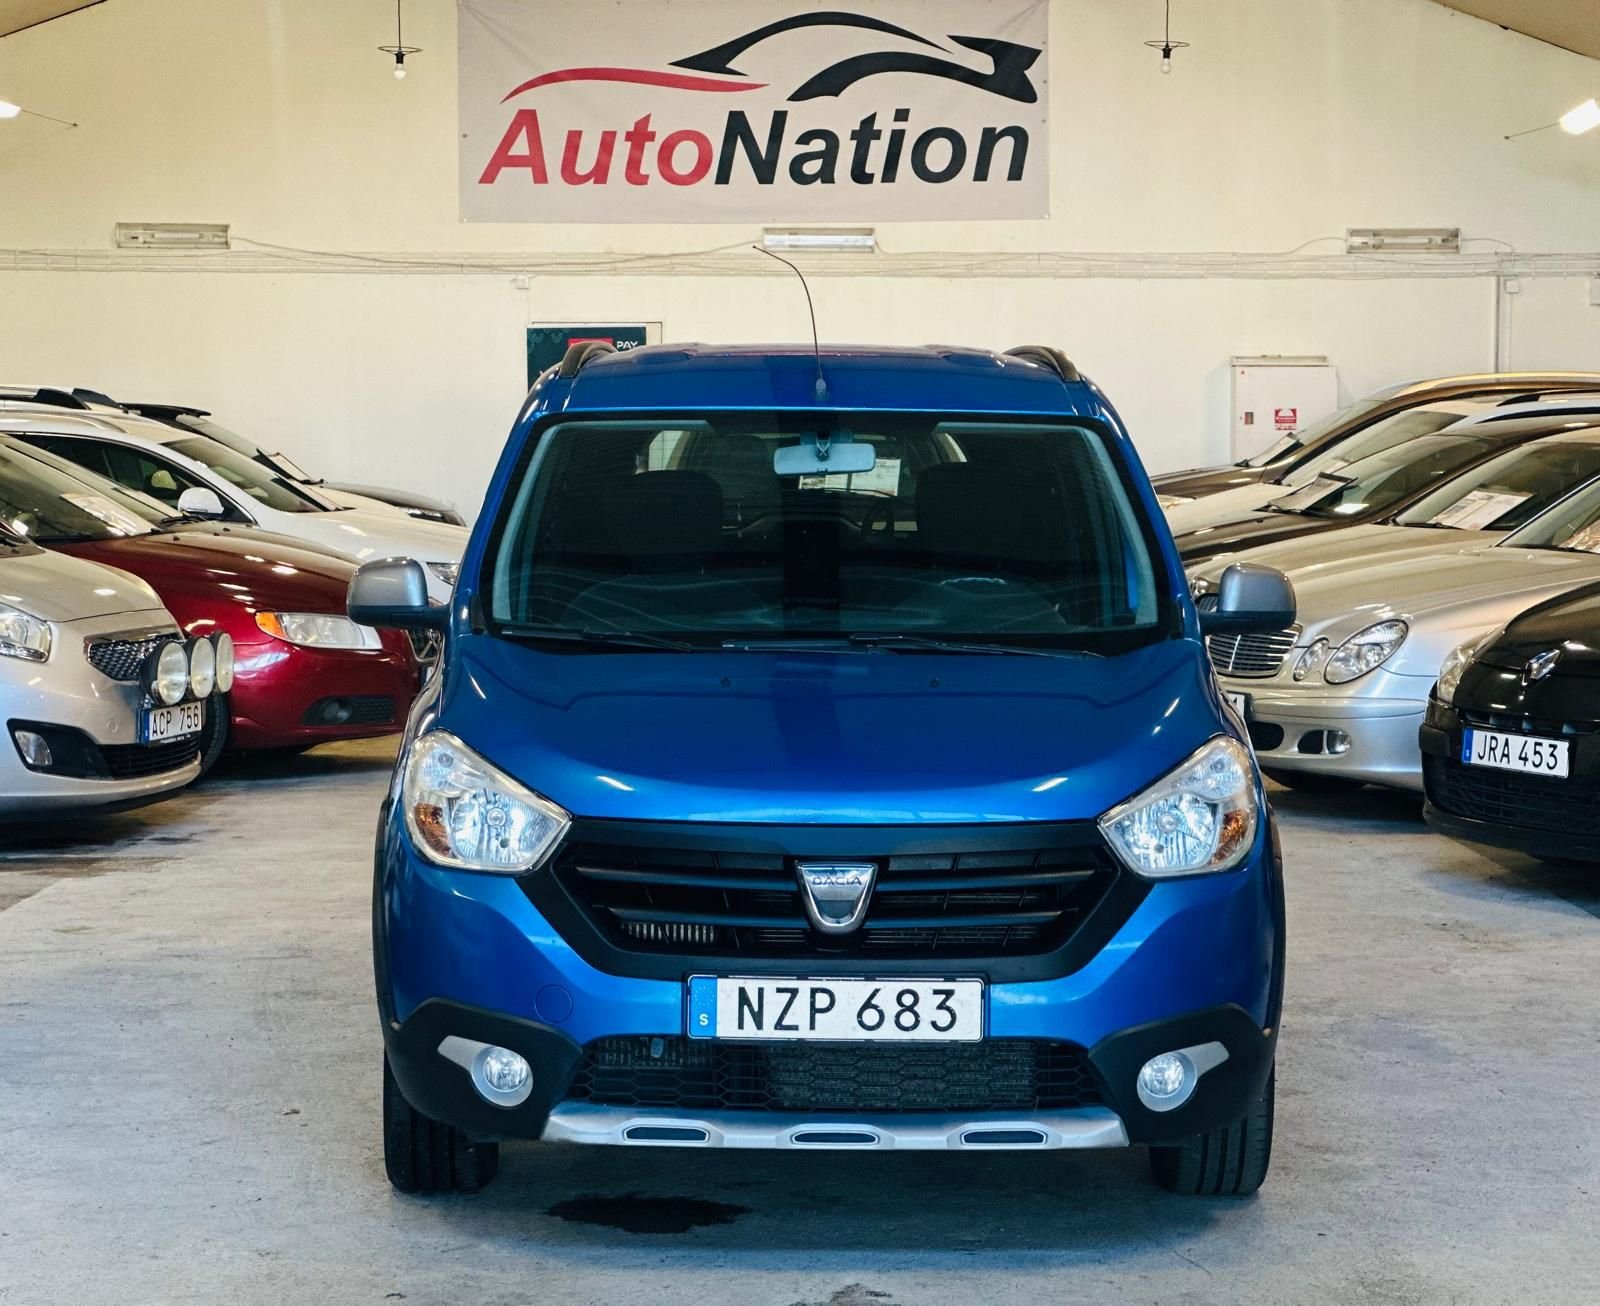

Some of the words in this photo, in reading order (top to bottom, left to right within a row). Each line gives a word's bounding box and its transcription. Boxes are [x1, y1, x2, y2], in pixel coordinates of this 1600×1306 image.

[478, 108, 1031, 186] AutoNation
[616, 340, 639, 349] PAY
[152, 710, 172, 737] ACP
[180, 705, 199, 730] 756
[1478, 734, 1511, 764] JRA
[1518, 740, 1558, 770] 453
[812, 876, 862, 886] DACIA
[698, 1013, 709, 1026] S
[737, 986, 837, 1031] NZP
[856, 988, 957, 1032] 683
